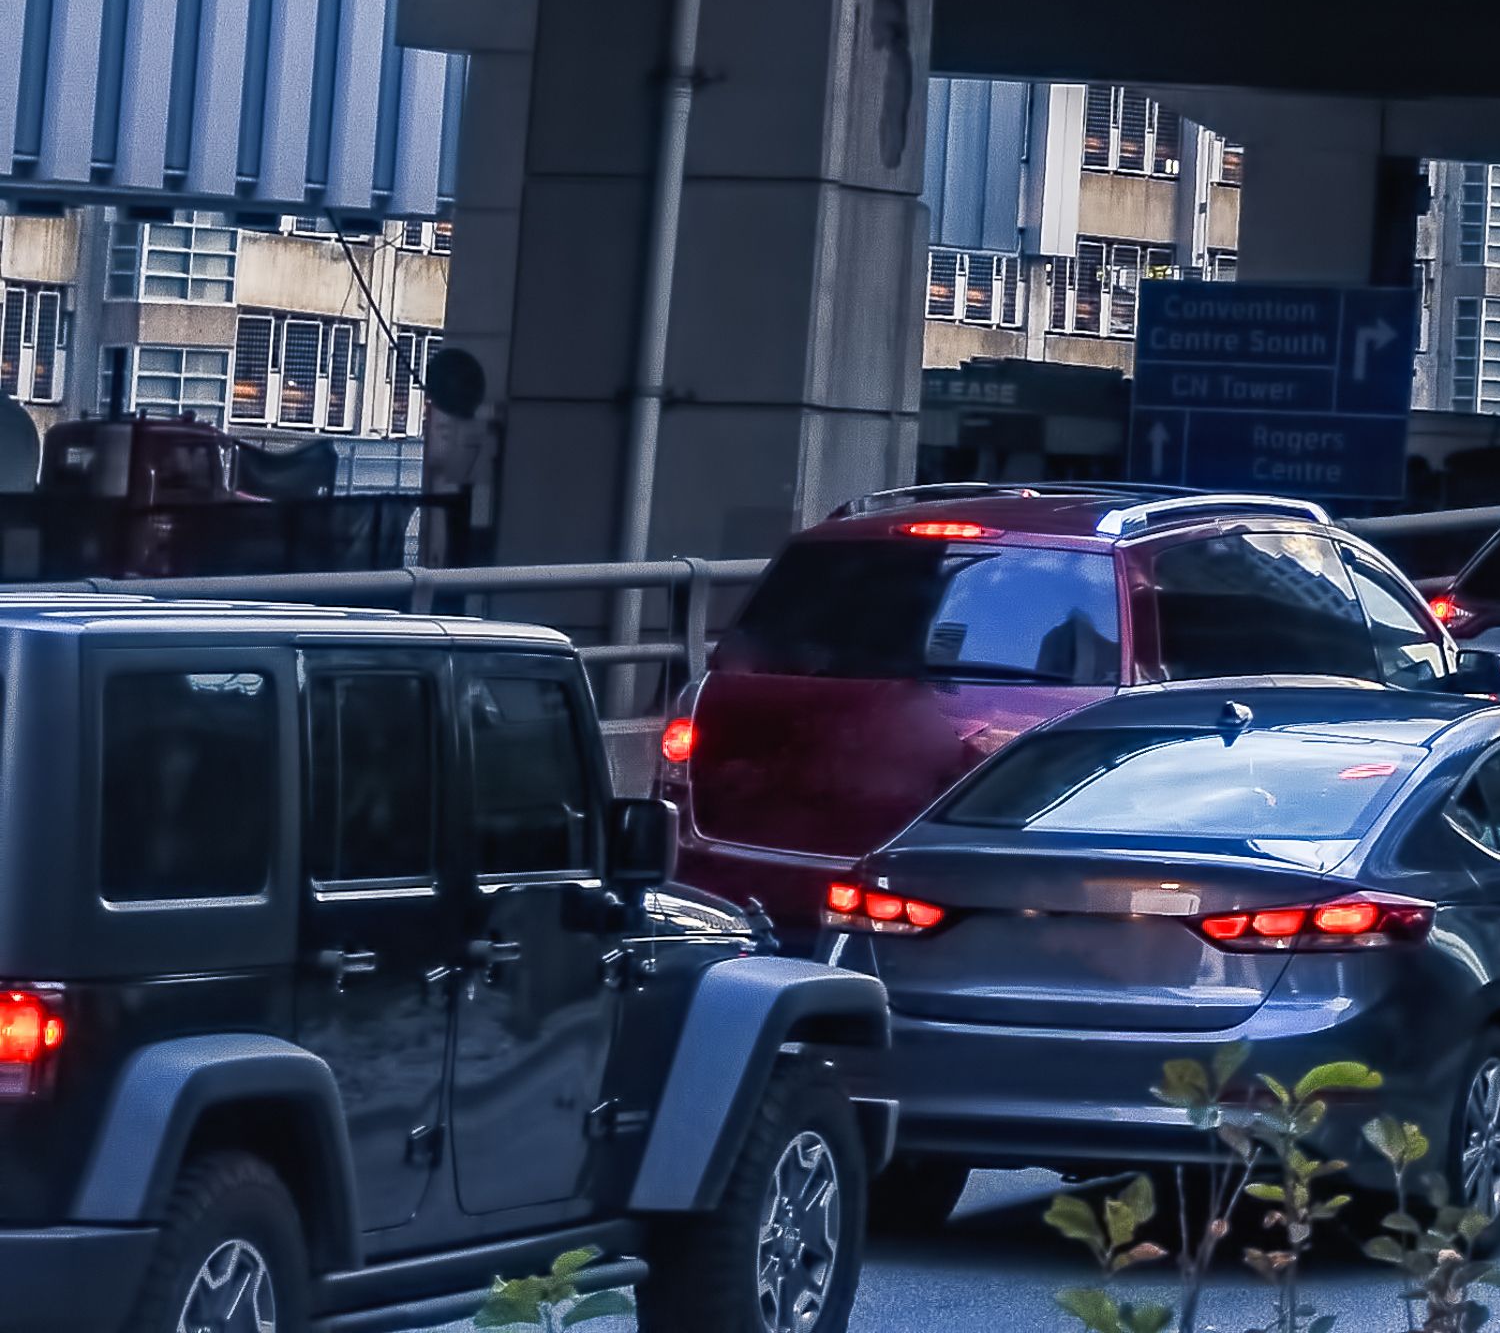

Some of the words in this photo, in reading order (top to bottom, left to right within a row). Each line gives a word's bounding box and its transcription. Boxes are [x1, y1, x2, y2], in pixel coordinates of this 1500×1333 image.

[1163, 294, 1316, 322] Convention
[1150, 326, 1240, 352] Centre
[1249, 329, 1326, 354] South
[1171, 373, 1208, 398] CN
[1220, 374, 1297, 400] Tower
[1253, 425, 1345, 454] Rogers
[1252, 457, 1341, 483] Centre
